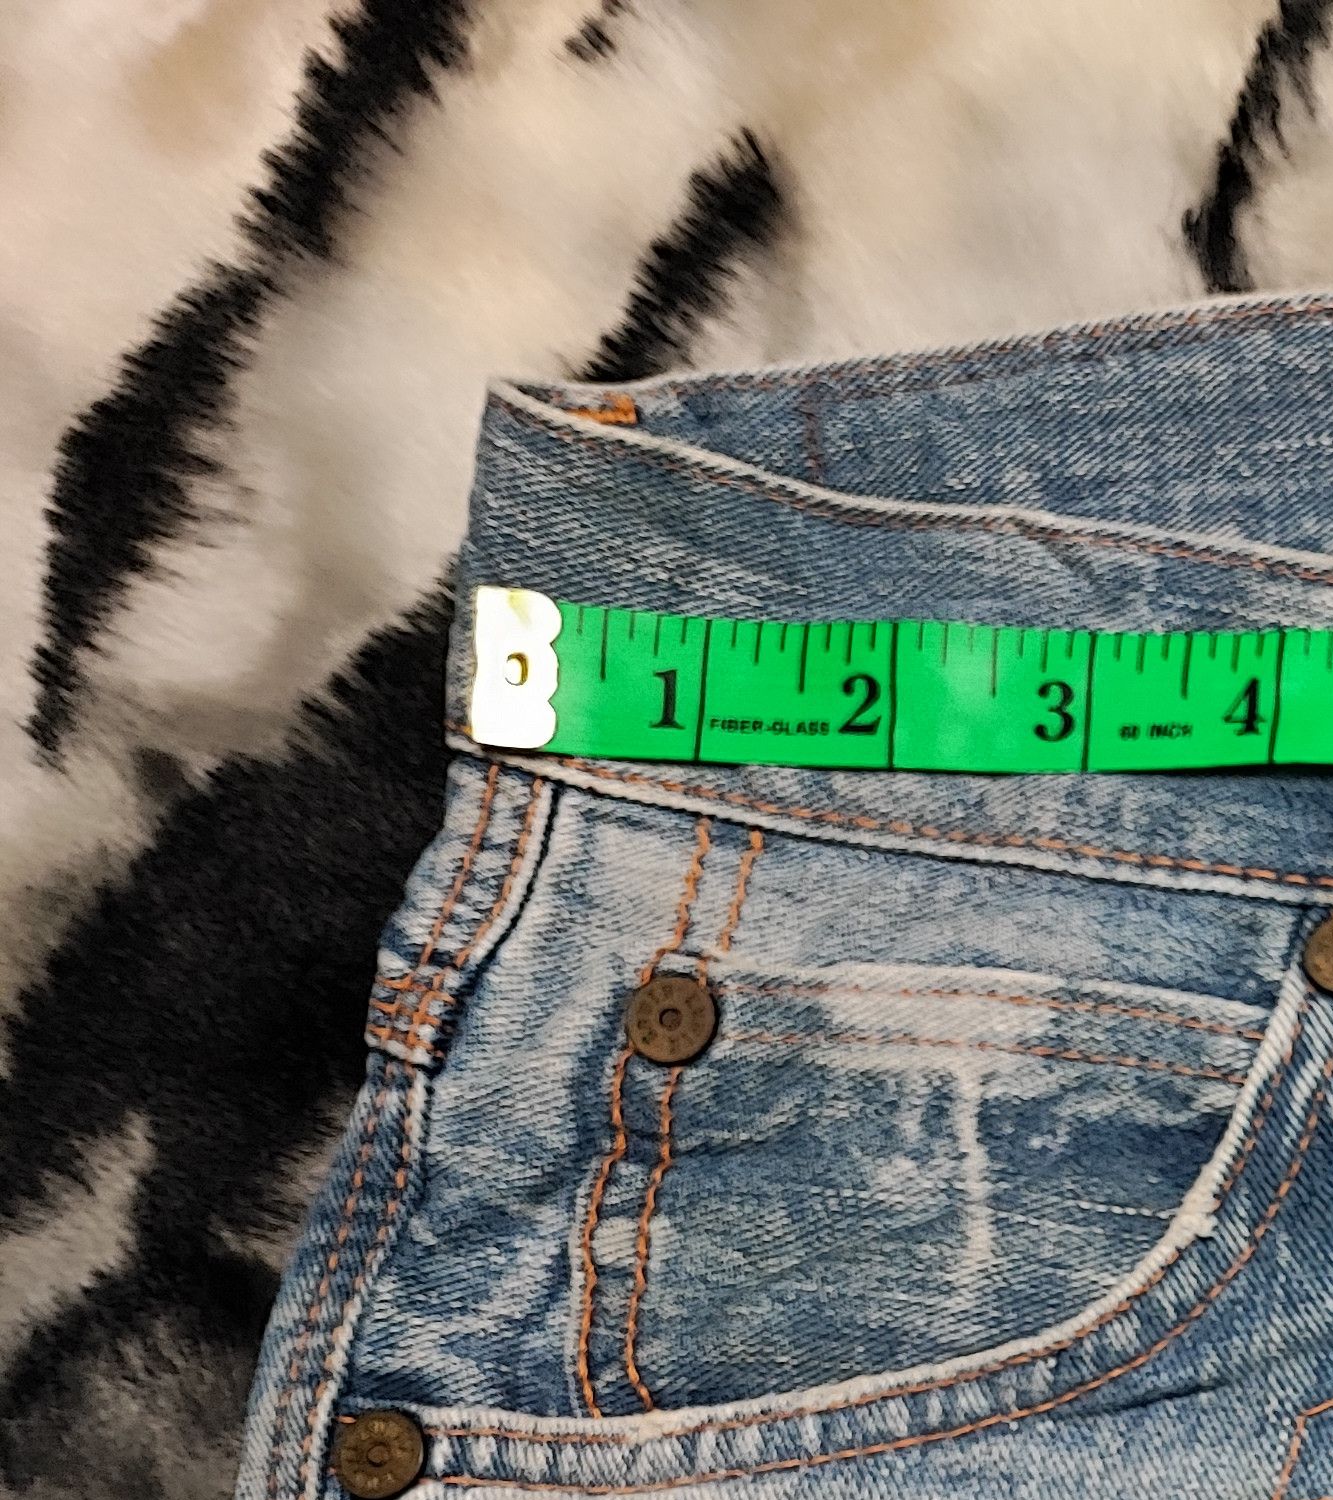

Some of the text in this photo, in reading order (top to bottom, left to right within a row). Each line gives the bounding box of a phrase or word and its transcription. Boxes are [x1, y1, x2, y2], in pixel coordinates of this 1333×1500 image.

[649, 669, 686, 731] 1
[838, 676, 882, 735] 2
[1034, 681, 1075, 742] 3
[1223, 678, 1263, 734] 4
[709, 716, 830, 738] FIBER-GLASS
[1150, 723, 1193, 739] INCH
